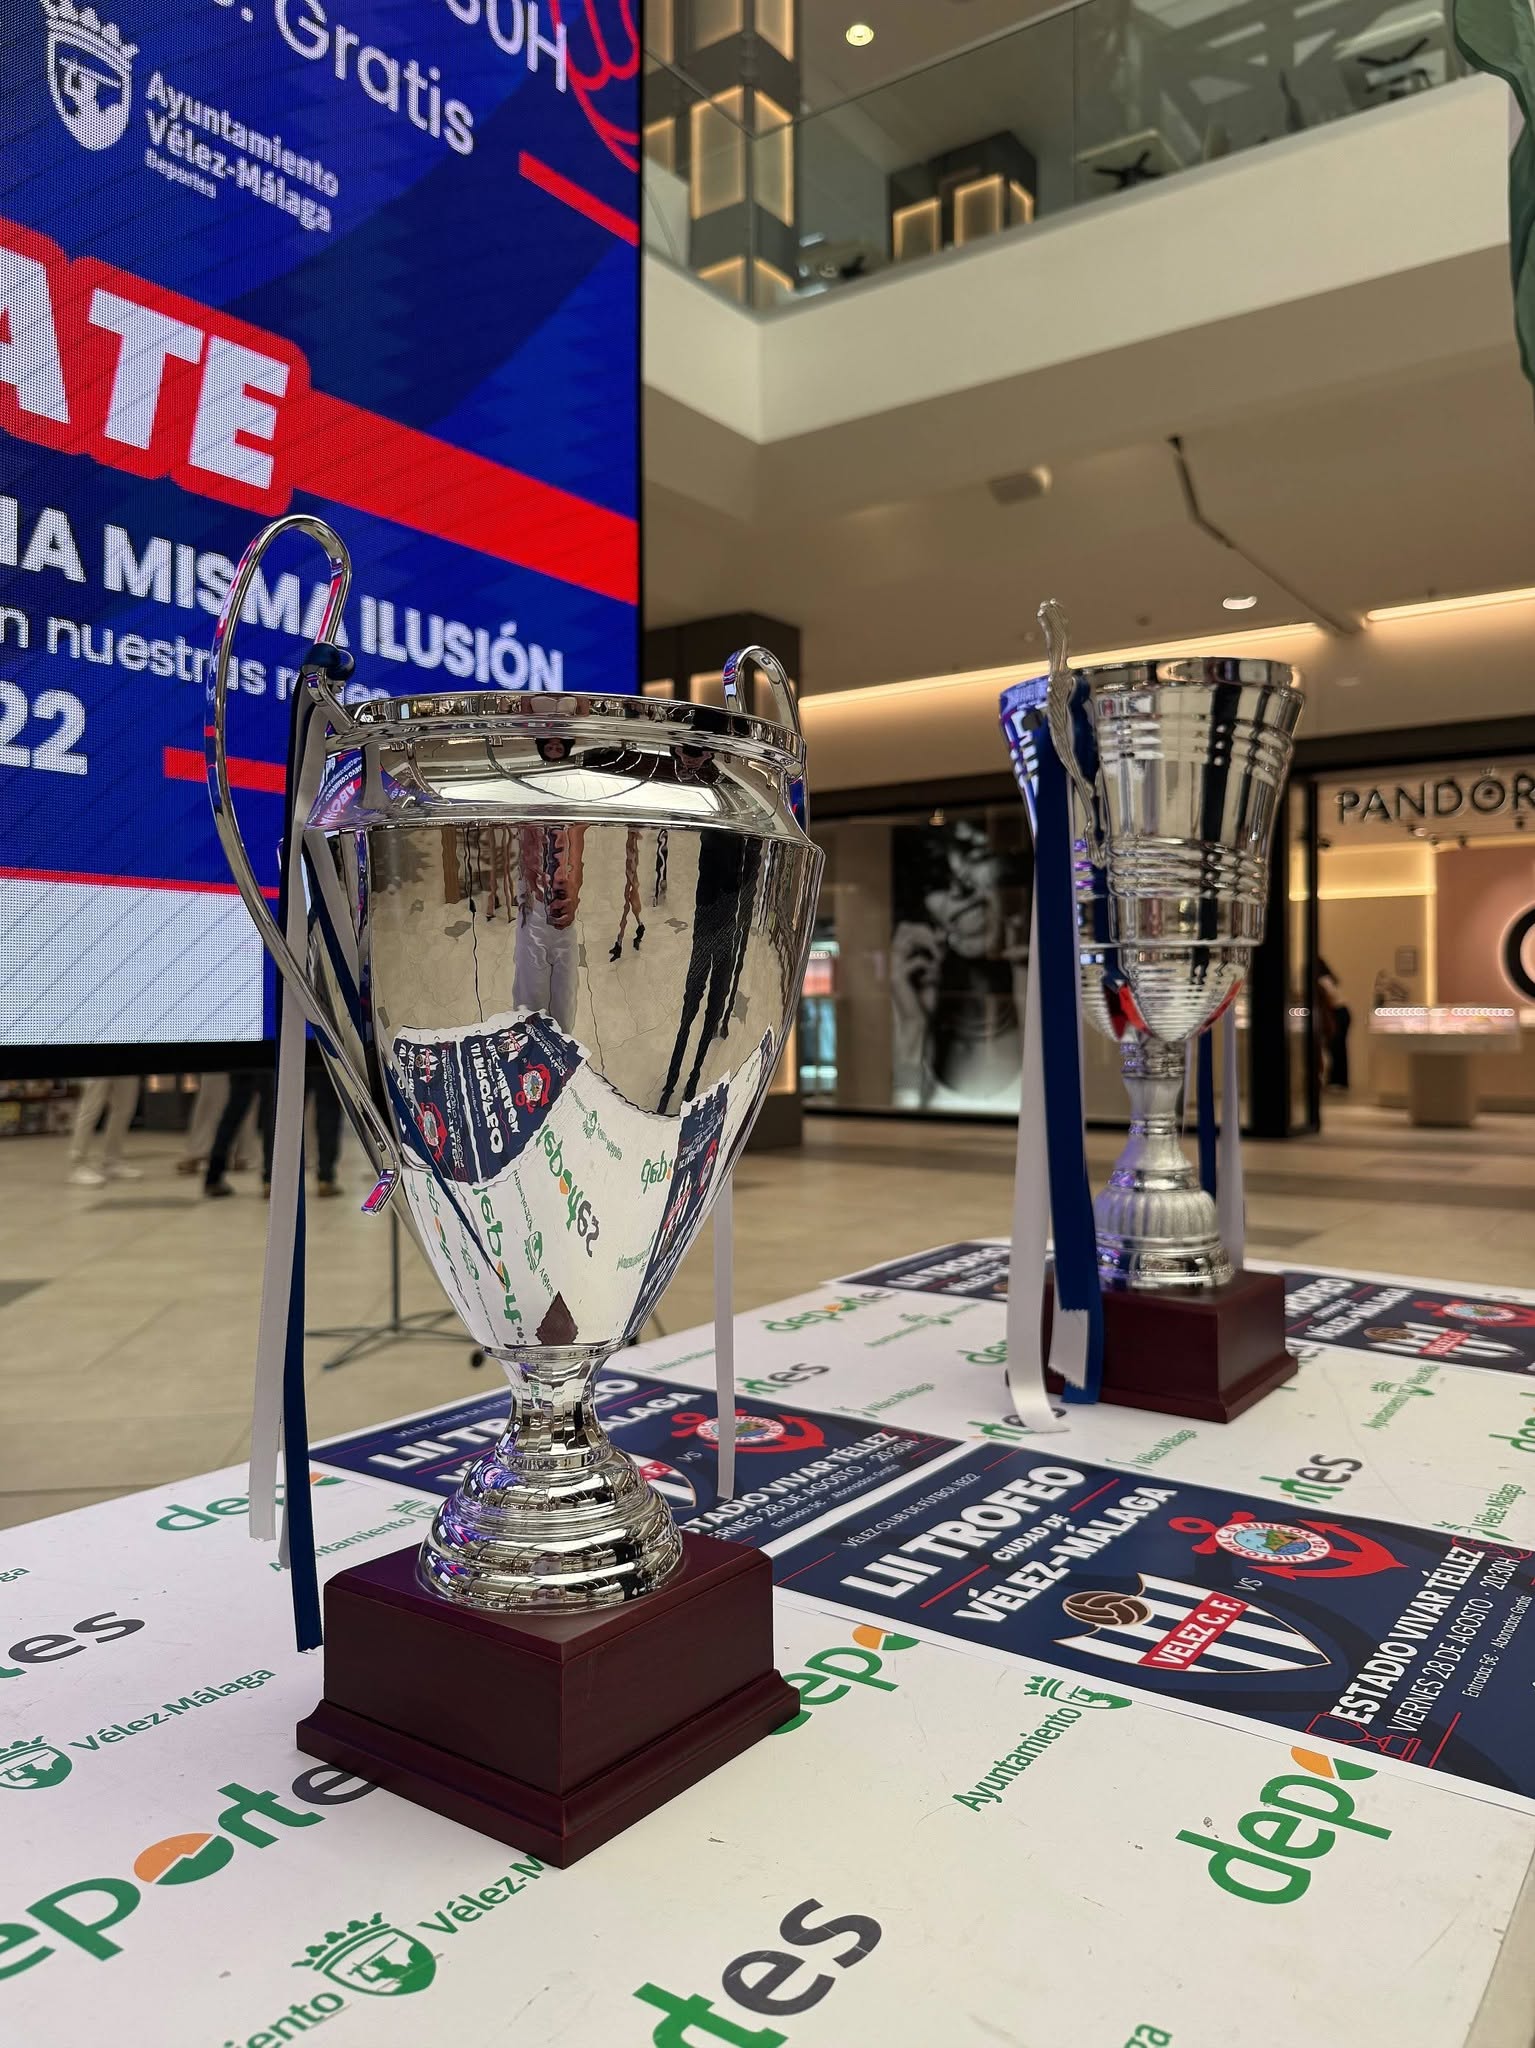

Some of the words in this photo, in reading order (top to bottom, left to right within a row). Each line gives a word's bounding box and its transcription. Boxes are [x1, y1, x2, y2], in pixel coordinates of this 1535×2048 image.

[275, 0, 474, 155] Gratis
[145, 70, 339, 198] Ayuntamiento
[145, 107, 331, 233] Vélez-Málaga
[104, 524, 349, 647] MISMA
[360, 594, 563, 691] ILUSIÓN
[757, 1503, 785, 1518] 28
[778, 1493, 808, 1507] DE
[802, 1464, 865, 1497] AGOSTO
[759, 1459, 839, 1495] VIVAR
[825, 1431, 900, 1463] TÉLLEZ
[269, 1517, 417, 1573] Antamiento
[839, 1553, 943, 1599] LII
[898, 1465, 1087, 1561] TROFEO
[841, 1527, 881, 1548] VÉLEZ
[876, 1511, 910, 1531] CLUB
[902, 1504, 924, 1516] DE
[952, 1485, 1179, 1623] VÉLEZ-MÁLAGA
[992, 1524, 1051, 1562] CIUDAD
[1047, 1512, 1071, 1530] DE
[1233, 1576, 1264, 1592] VS
[1420, 1545, 1487, 1591] TÉLLEZ
[1479, 1557, 1521, 1591] 20:30H
[1387, 1590, 1456, 1640] VIVAR
[1446, 1598, 1494, 1646] AGOSTO
[1152, 1621, 1217, 1666] VELEZ
[1421, 1660, 1457, 1680] 28
[1433, 1642, 1468, 1663] DE
[1461, 1663, 1494, 1698] Entrada:
[1510, 1594, 1534, 1616] Gratis
[68, 1669, 277, 1751] Vélez-Málaga
[1328, 1641, 1418, 1725] ESTADIO
[1386, 1678, 1446, 1733] VIERNES
[952, 1707, 1083, 1813] Ayuntamiento
[416, 1854, 546, 1935] Vélez-M
